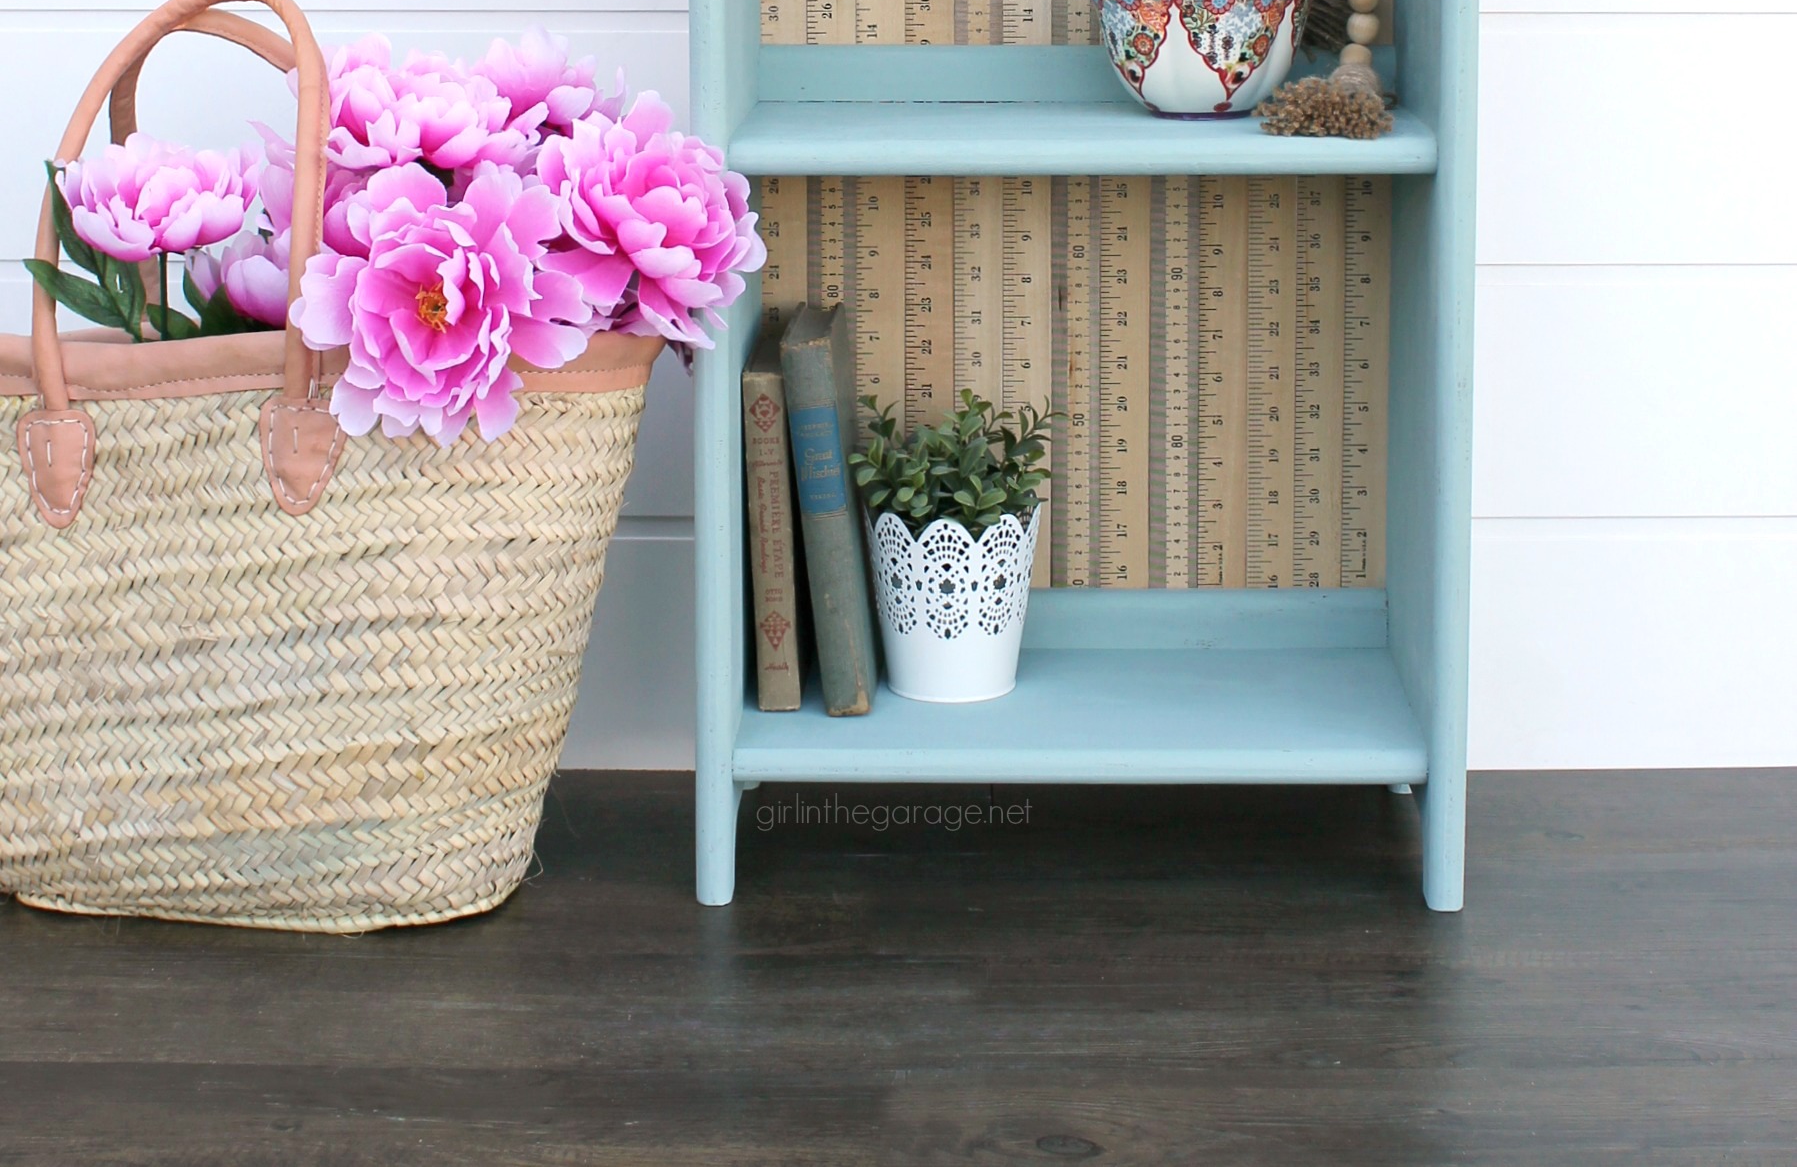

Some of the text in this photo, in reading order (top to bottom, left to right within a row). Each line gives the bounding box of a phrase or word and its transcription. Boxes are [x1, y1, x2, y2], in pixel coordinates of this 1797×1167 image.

[769, 6, 780, 21] 30
[822, 3, 833, 18] 26
[1022, 9, 1034, 21] 14
[866, 25, 878, 37] 14
[1212, 194, 1224, 208] 10
[768, 222, 780, 279] 24 25
[1212, 247, 1224, 255] 9
[970, 181, 983, 367] 30 31 32 33 34
[1020, 181, 1032, 368] 6 7 8 9 10
[827, 284, 839, 298] 80
[868, 196, 881, 384] 6 7 8 9 10
[1212, 289, 1224, 297] 8
[921, 212, 933, 398] 21 22 23 24 25
[1073, 245, 1085, 426] 50 60
[1212, 331, 1224, 339] 7
[1171, 267, 1183, 448] 80 90
[1359, 361, 1370, 369] 6
[1116, 183, 1128, 579] 16 17 18 19 20 21 22 23 24 25
[1212, 374, 1224, 382] 6
[1268, 280, 1280, 546] 17 18 19 20 21 22 23
[1358, 404, 1369, 412] 5
[1212, 417, 1224, 425] 5
[804, 448, 833, 465] Great
[1358, 446, 1368, 454] 4
[1212, 459, 1224, 467] 4
[1309, 405, 1321, 587] 28 29 30 31 32
[1357, 488, 1368, 496] 3
[1212, 501, 1224, 509] 3
[774, 539, 785, 579] ÉTAPE
